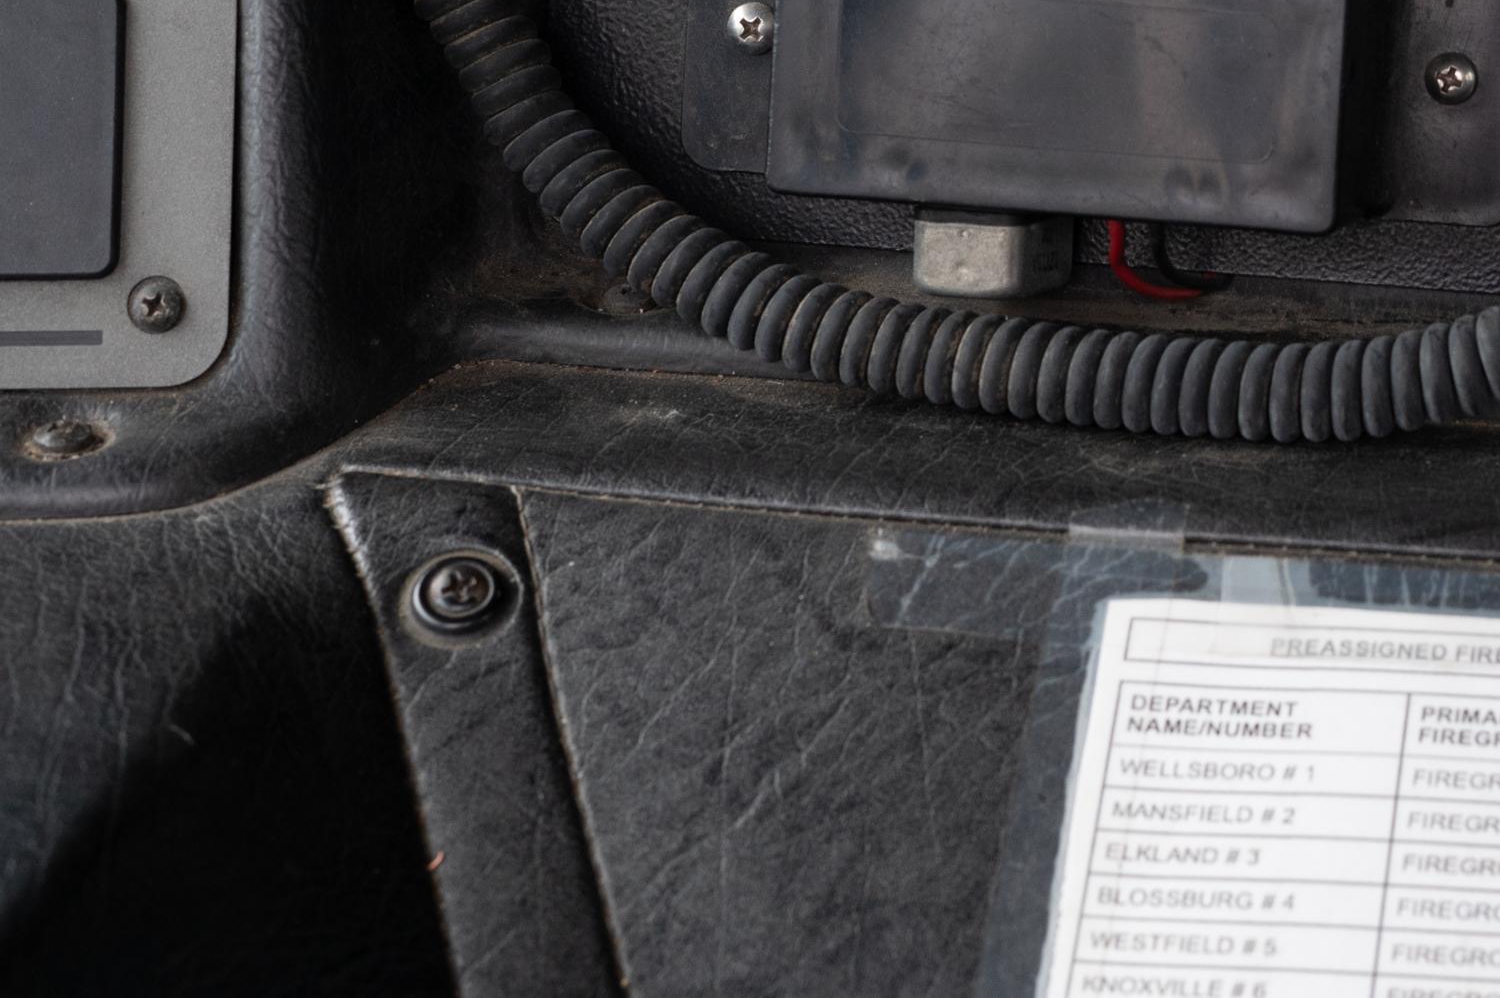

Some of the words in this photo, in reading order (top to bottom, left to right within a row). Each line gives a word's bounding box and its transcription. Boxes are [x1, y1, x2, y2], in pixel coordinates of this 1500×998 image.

[1270, 637, 1447, 661] PREASSIGNED
[1130, 694, 1299, 717] DEPARTMENT
[1127, 716, 1313, 739] NAME/NUMBER
[1120, 757, 1274, 782] WELLSBORO
[1306, 765, 1316, 782] 1
[1112, 801, 1253, 824] MANSFIELD
[1283, 807, 1296, 825] 2
[1104, 842, 1218, 865] ELKLAND
[1247, 848, 1261, 866] 3
[1097, 886, 1253, 910] BLOSSBURG
[1282, 893, 1296, 910] 4
[1090, 931, 1235, 955] WESTFIELD
[1264, 938, 1278, 956] 5
[1082, 975, 1223, 998] KNOXVILLE
